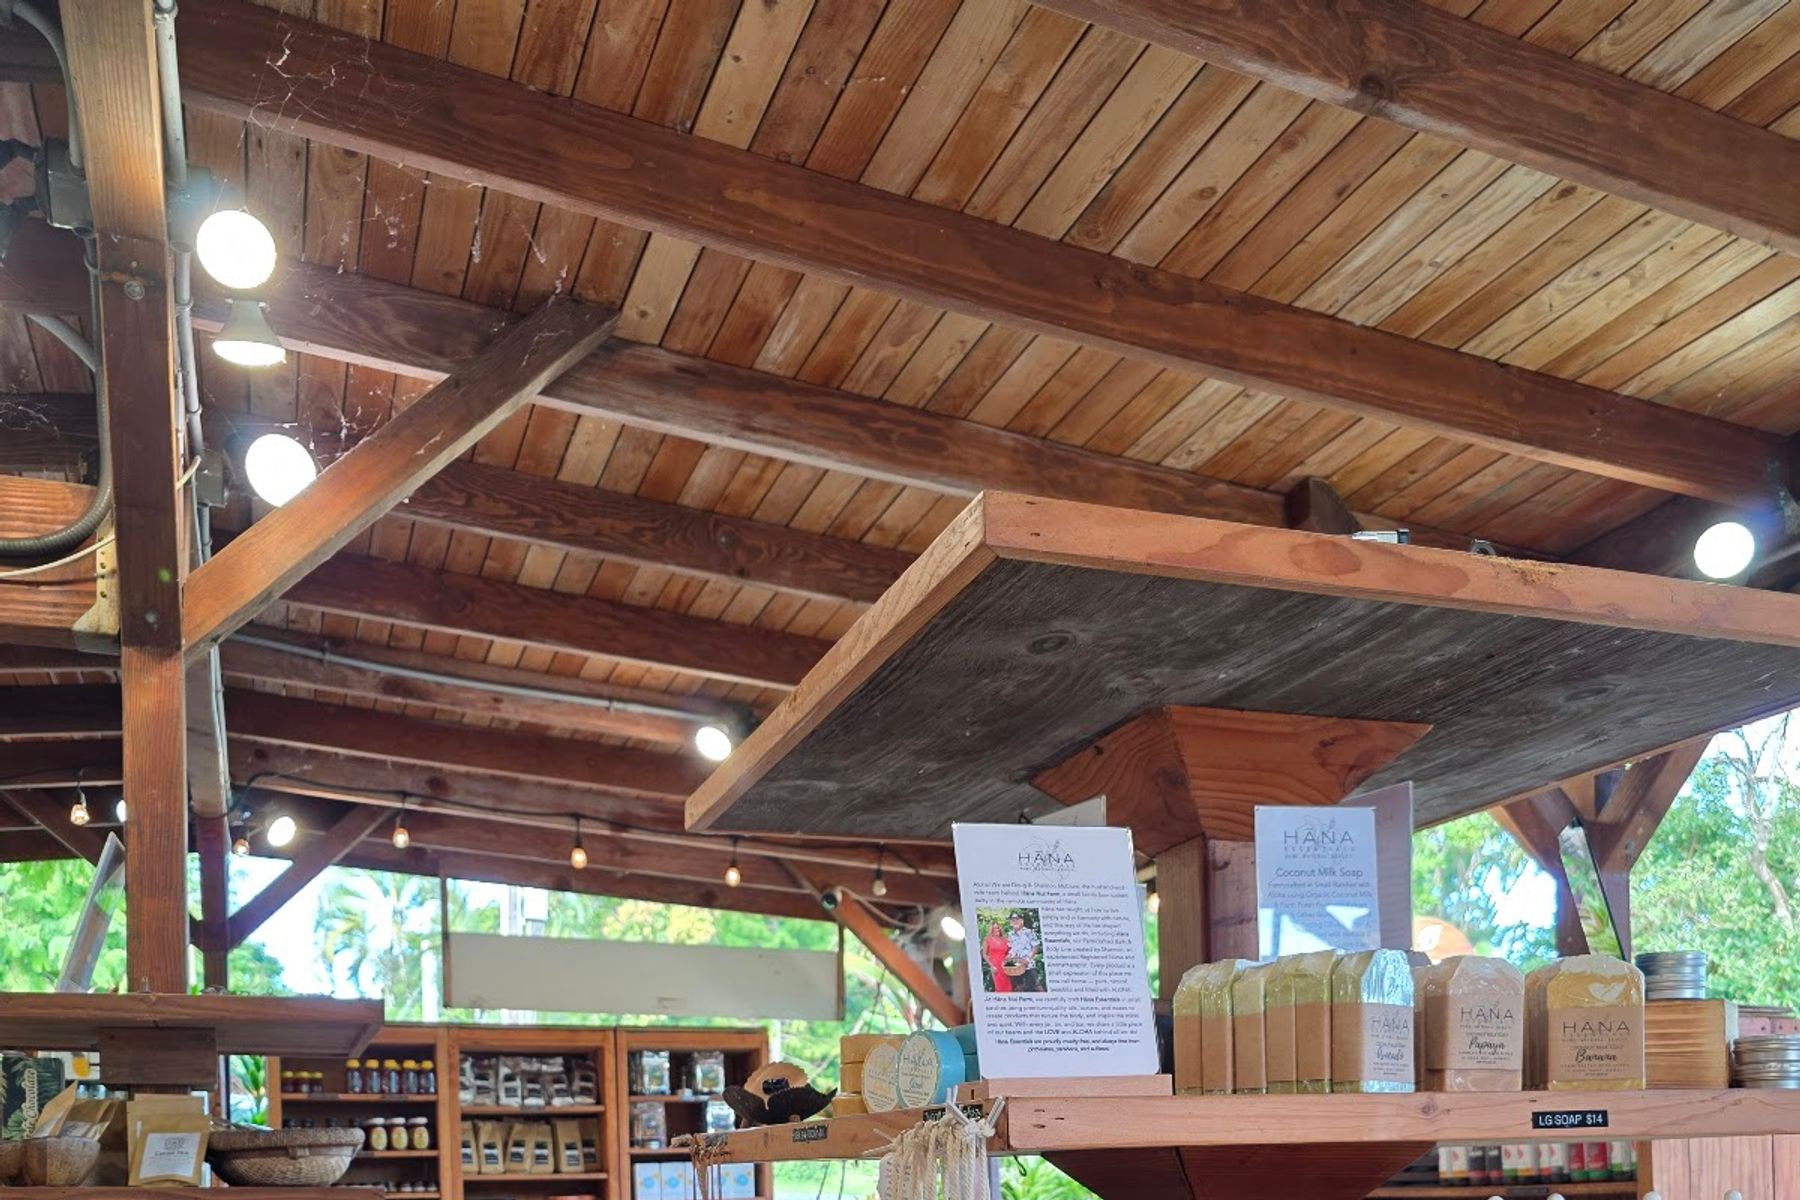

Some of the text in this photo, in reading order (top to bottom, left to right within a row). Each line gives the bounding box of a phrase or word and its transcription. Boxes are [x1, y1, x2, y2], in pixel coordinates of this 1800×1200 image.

[1275, 867, 1363, 879] Coconut Milk Soap
[1539, 1114, 1603, 1126] LG SOAP $14
